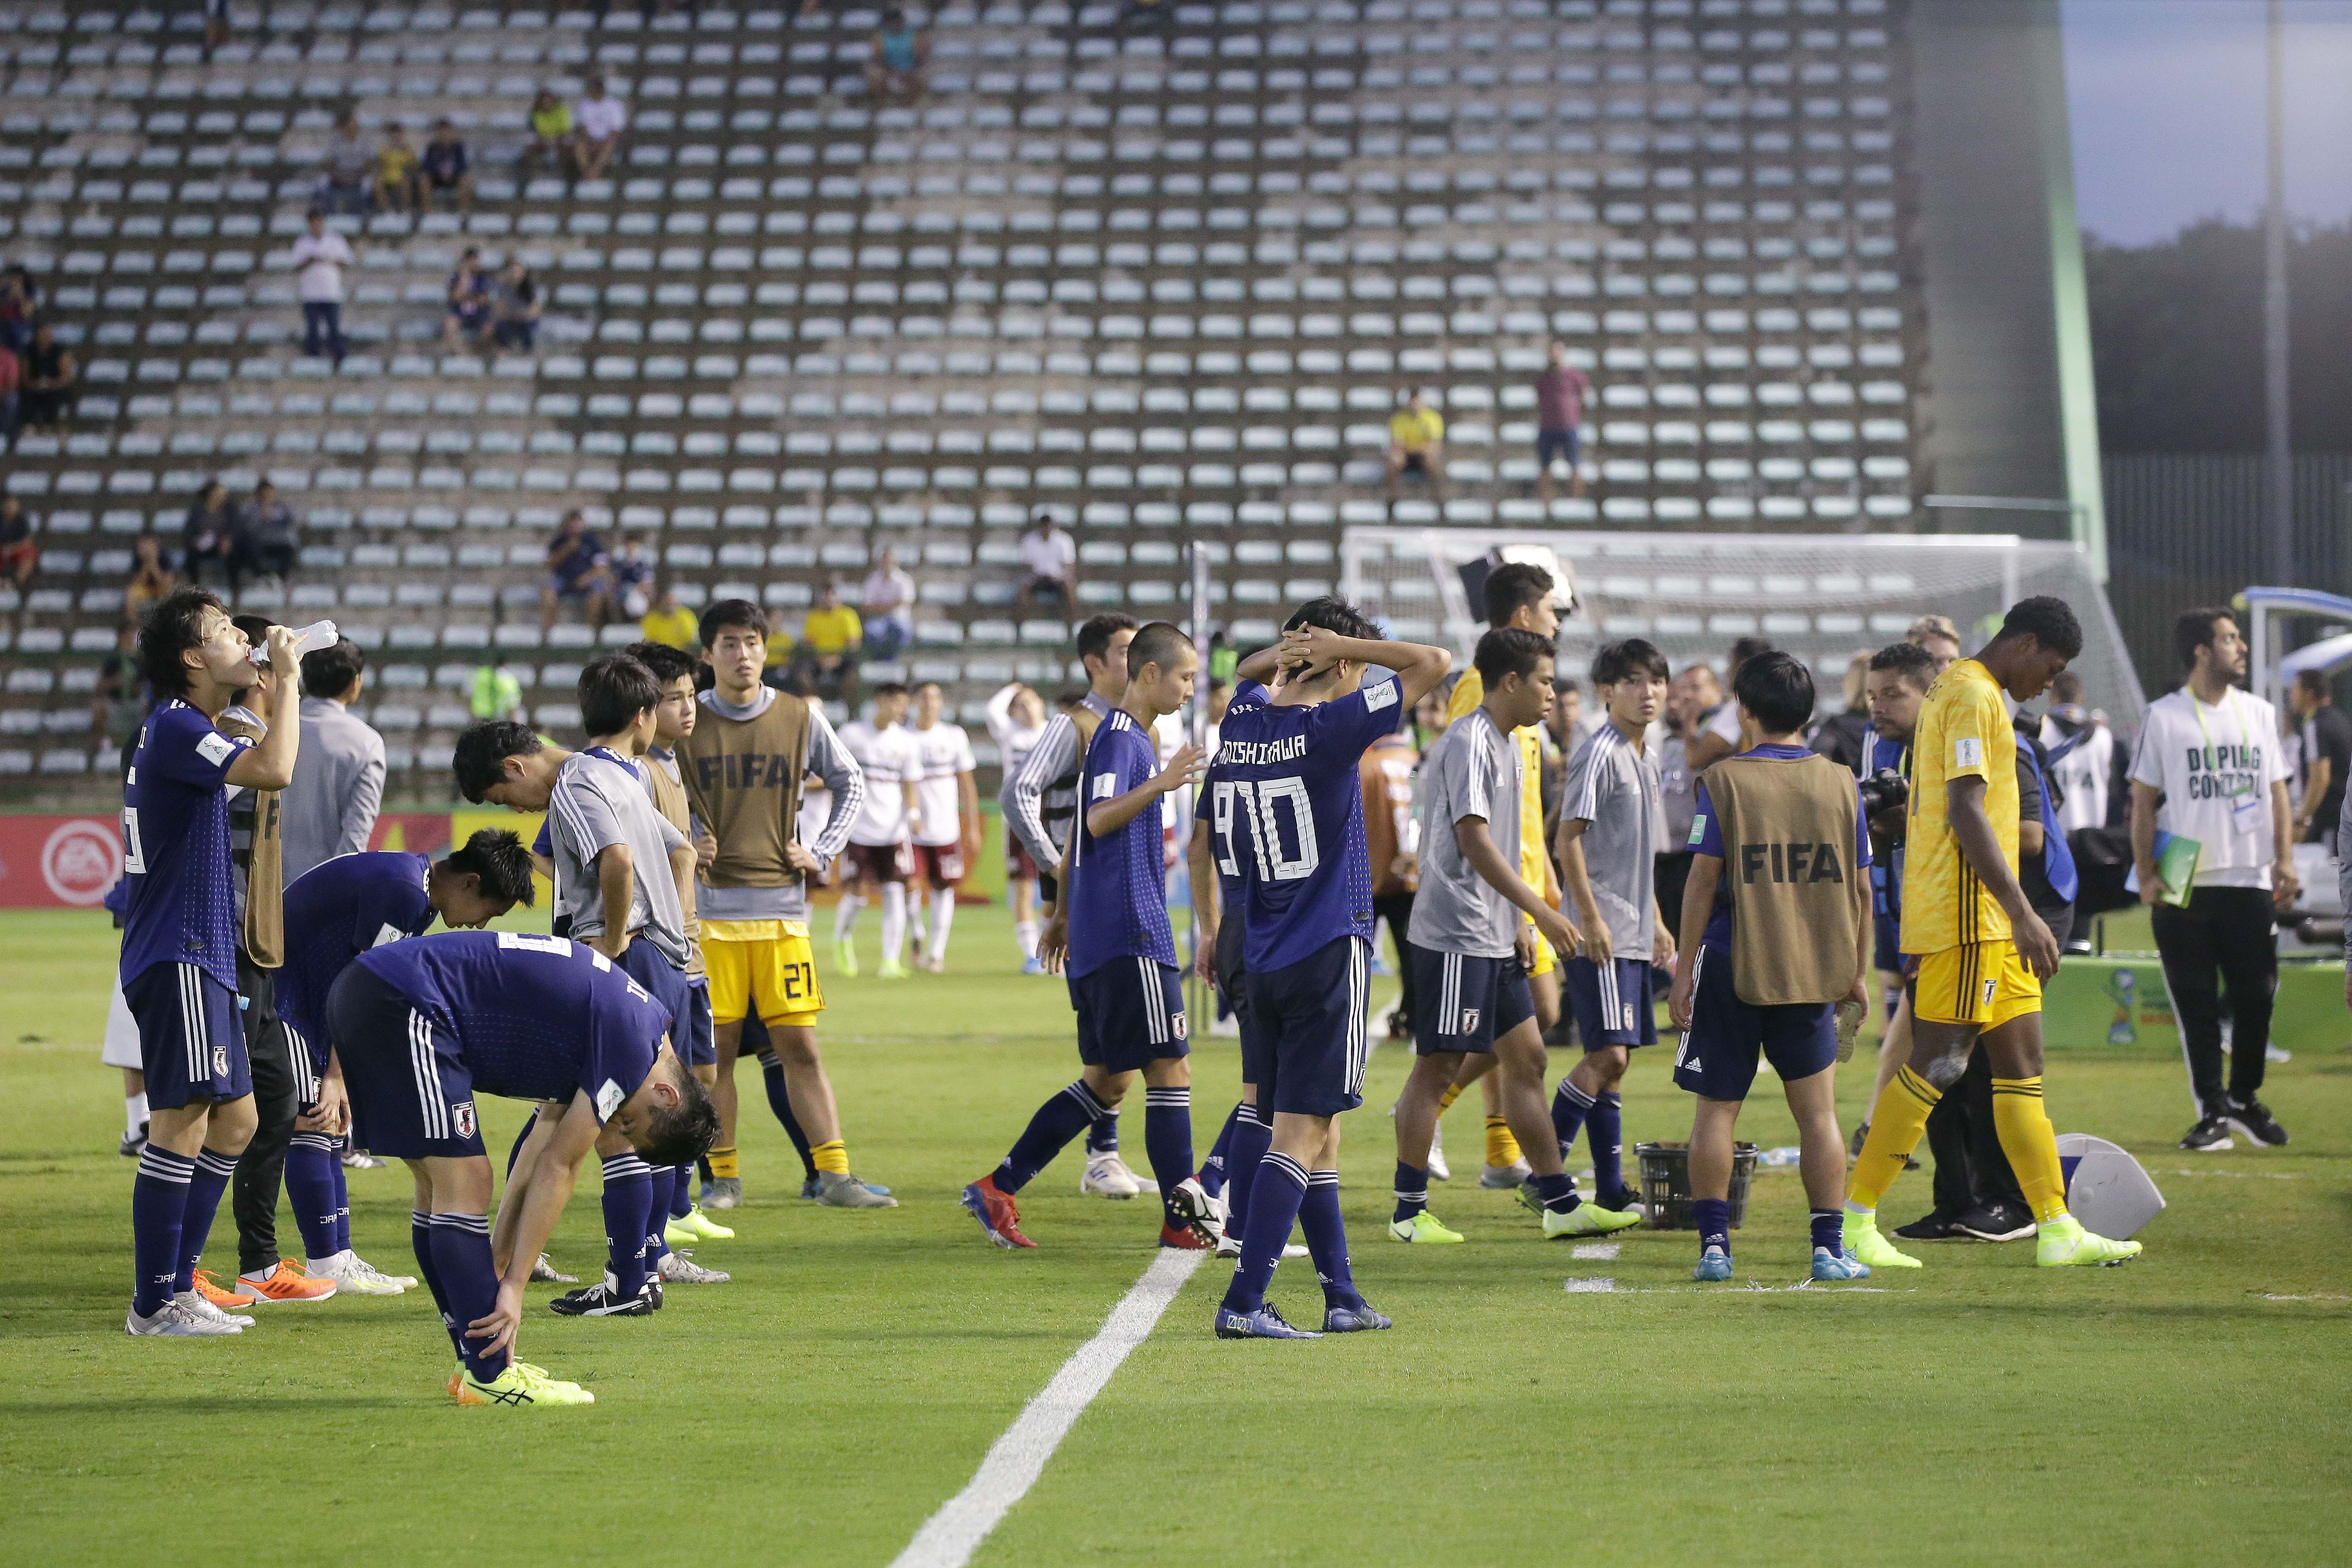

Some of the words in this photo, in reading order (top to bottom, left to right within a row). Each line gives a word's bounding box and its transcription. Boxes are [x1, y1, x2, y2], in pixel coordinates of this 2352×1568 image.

[697, 754, 791, 791] FIFA
[1213, 781, 1240, 877] 9
[1234, 776, 1319, 882] 10
[1741, 843, 1844, 884] FIFA
[784, 962, 812, 999] 21
